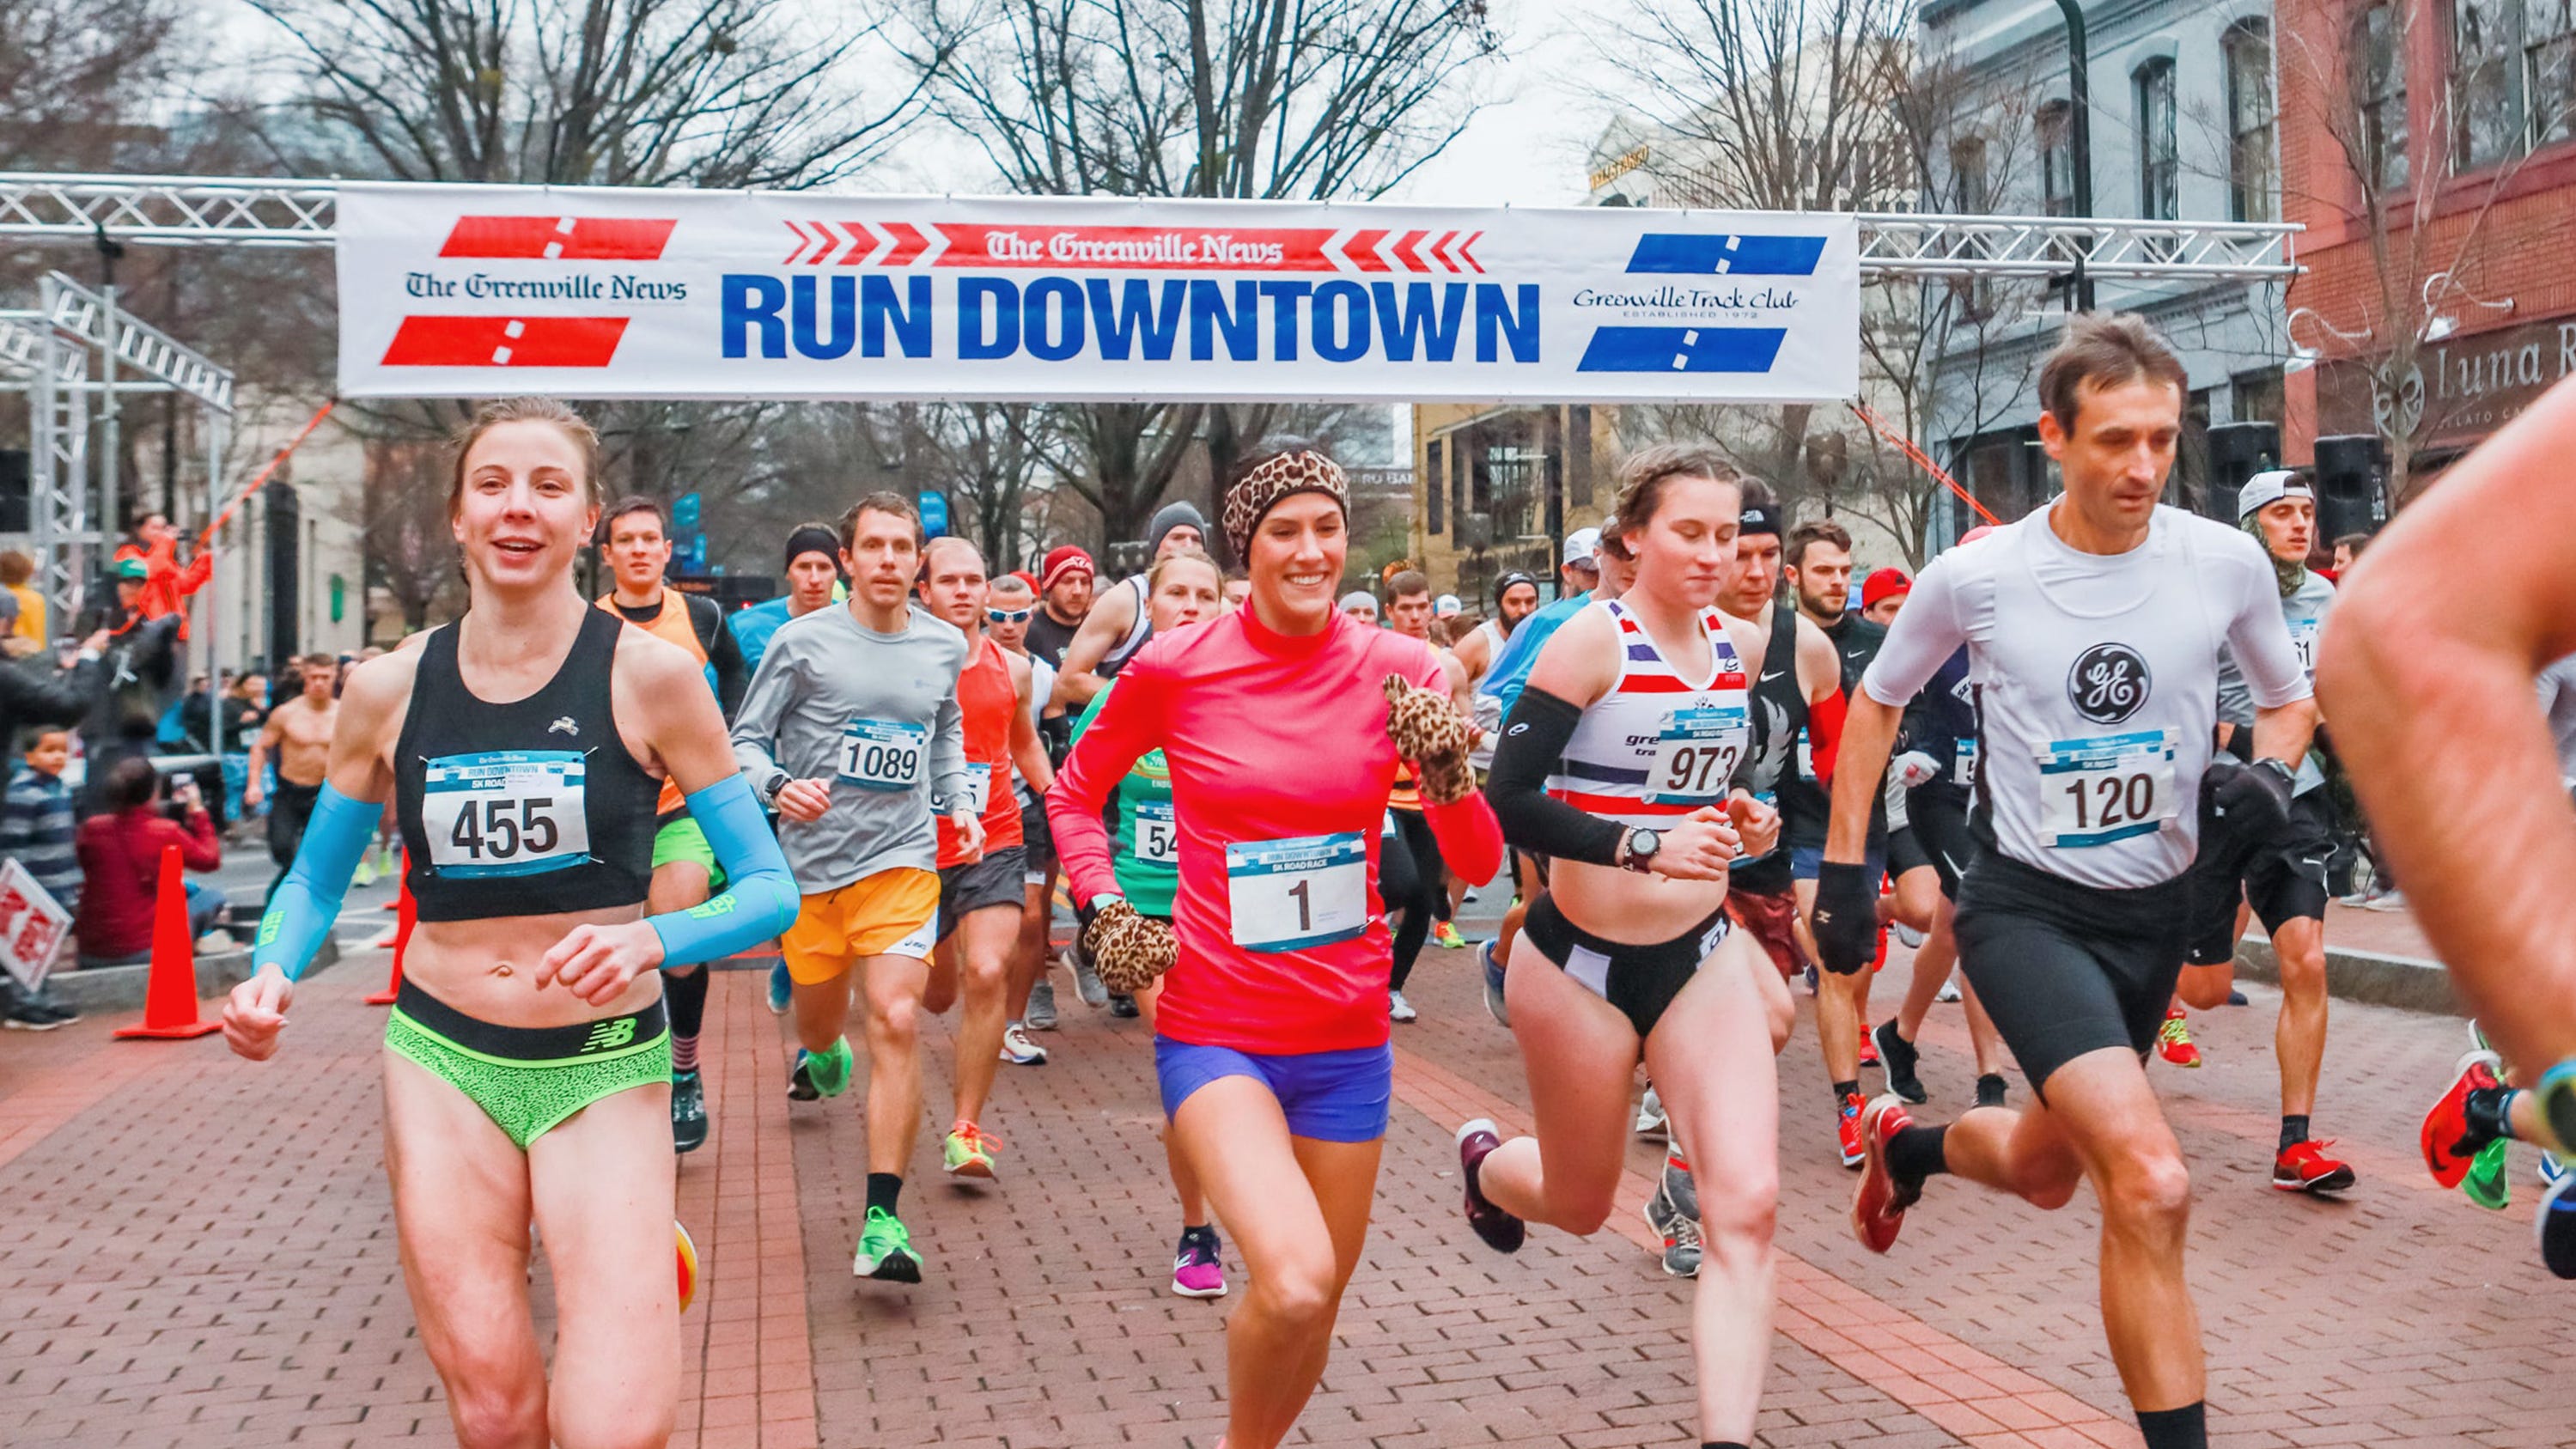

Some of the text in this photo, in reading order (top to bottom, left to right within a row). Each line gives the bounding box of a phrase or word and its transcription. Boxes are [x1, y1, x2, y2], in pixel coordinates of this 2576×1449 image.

[984, 230, 1285, 264] The Greenville News
[405, 271, 688, 301] The Greenville News
[1573, 286, 1800, 309] Greenville Track Club
[722, 273, 1541, 364] RUN DOWNTOWN
[1622, 310, 1759, 320] ESTABLISHED 1972
[847, 742, 918, 780] 1089
[1666, 745, 1738, 791] 973
[2065, 772, 2154, 829] 120
[452, 797, 559, 859] 455
[1283, 861, 1306, 872] ROAD
[1288, 880, 1311, 931] 1
